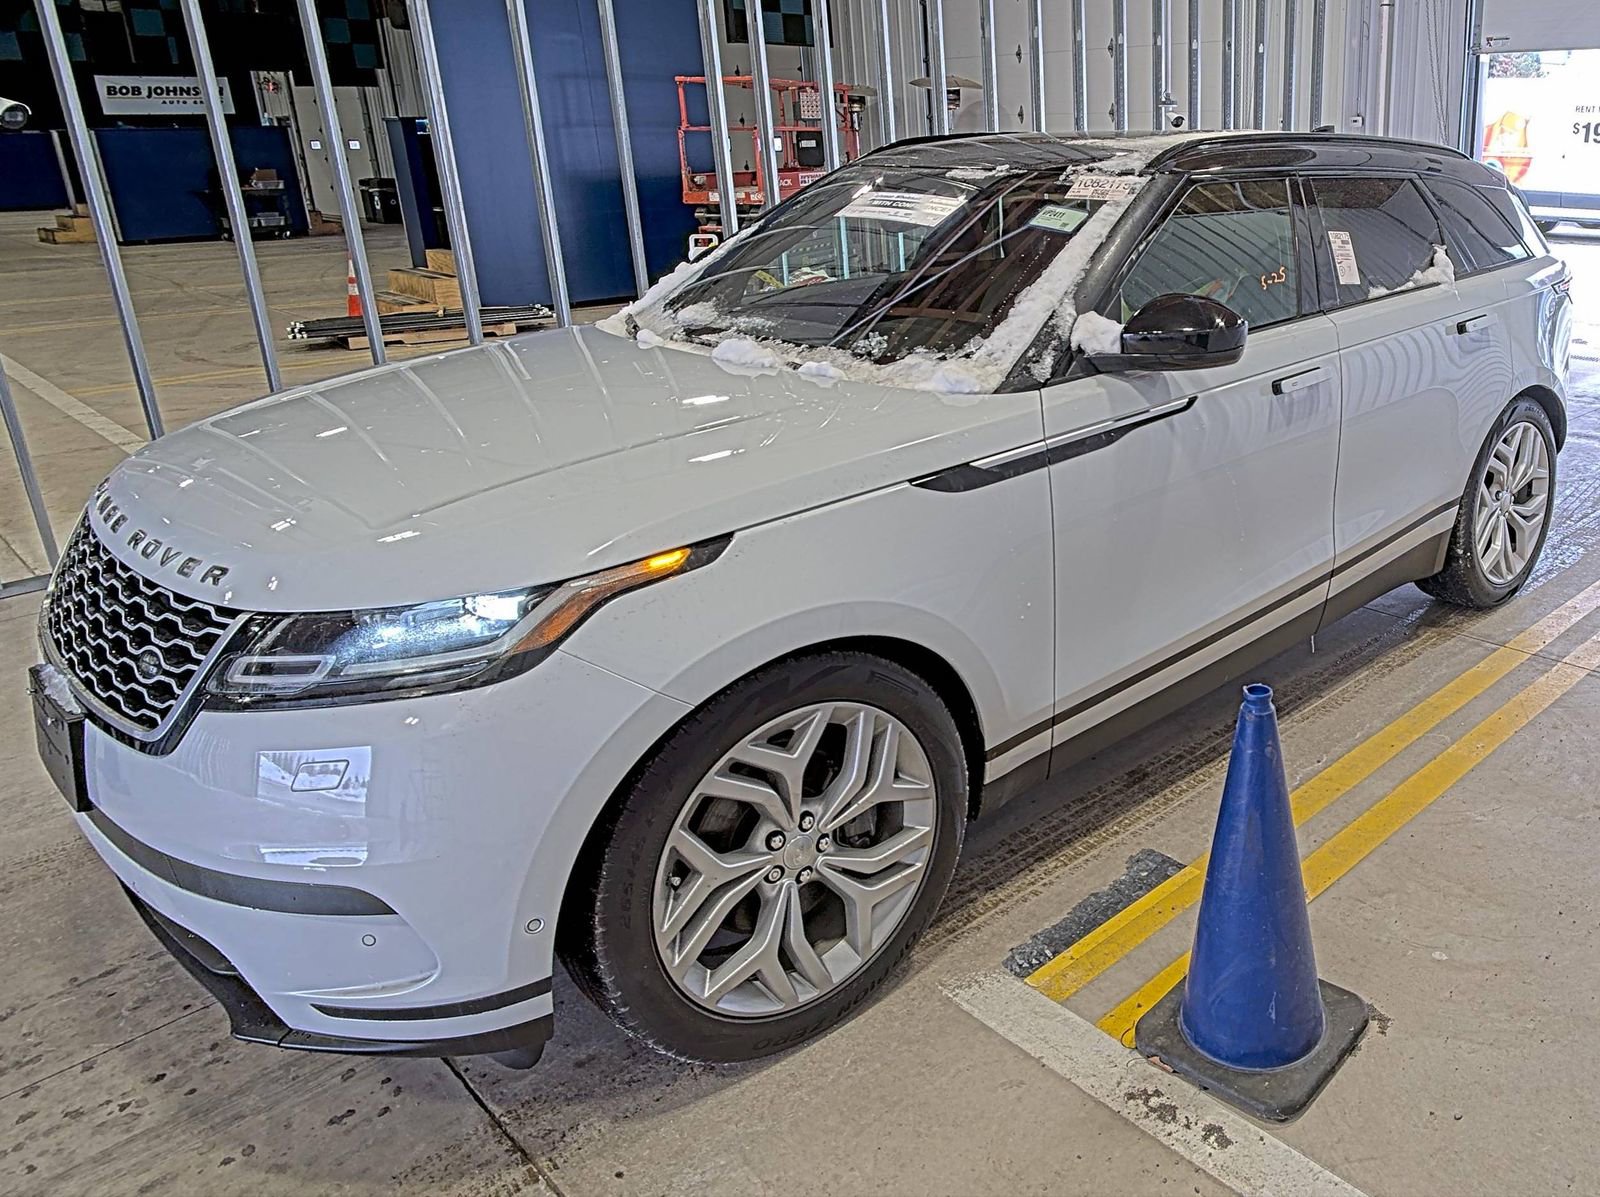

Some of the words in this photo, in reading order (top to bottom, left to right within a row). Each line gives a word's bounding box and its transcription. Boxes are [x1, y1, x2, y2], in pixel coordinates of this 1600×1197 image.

[106, 85, 142, 97] BOB
[145, 86, 224, 99] JOHNS
[1575, 105, 1596, 113] RENT
[126, 529, 230, 586] ROVER
